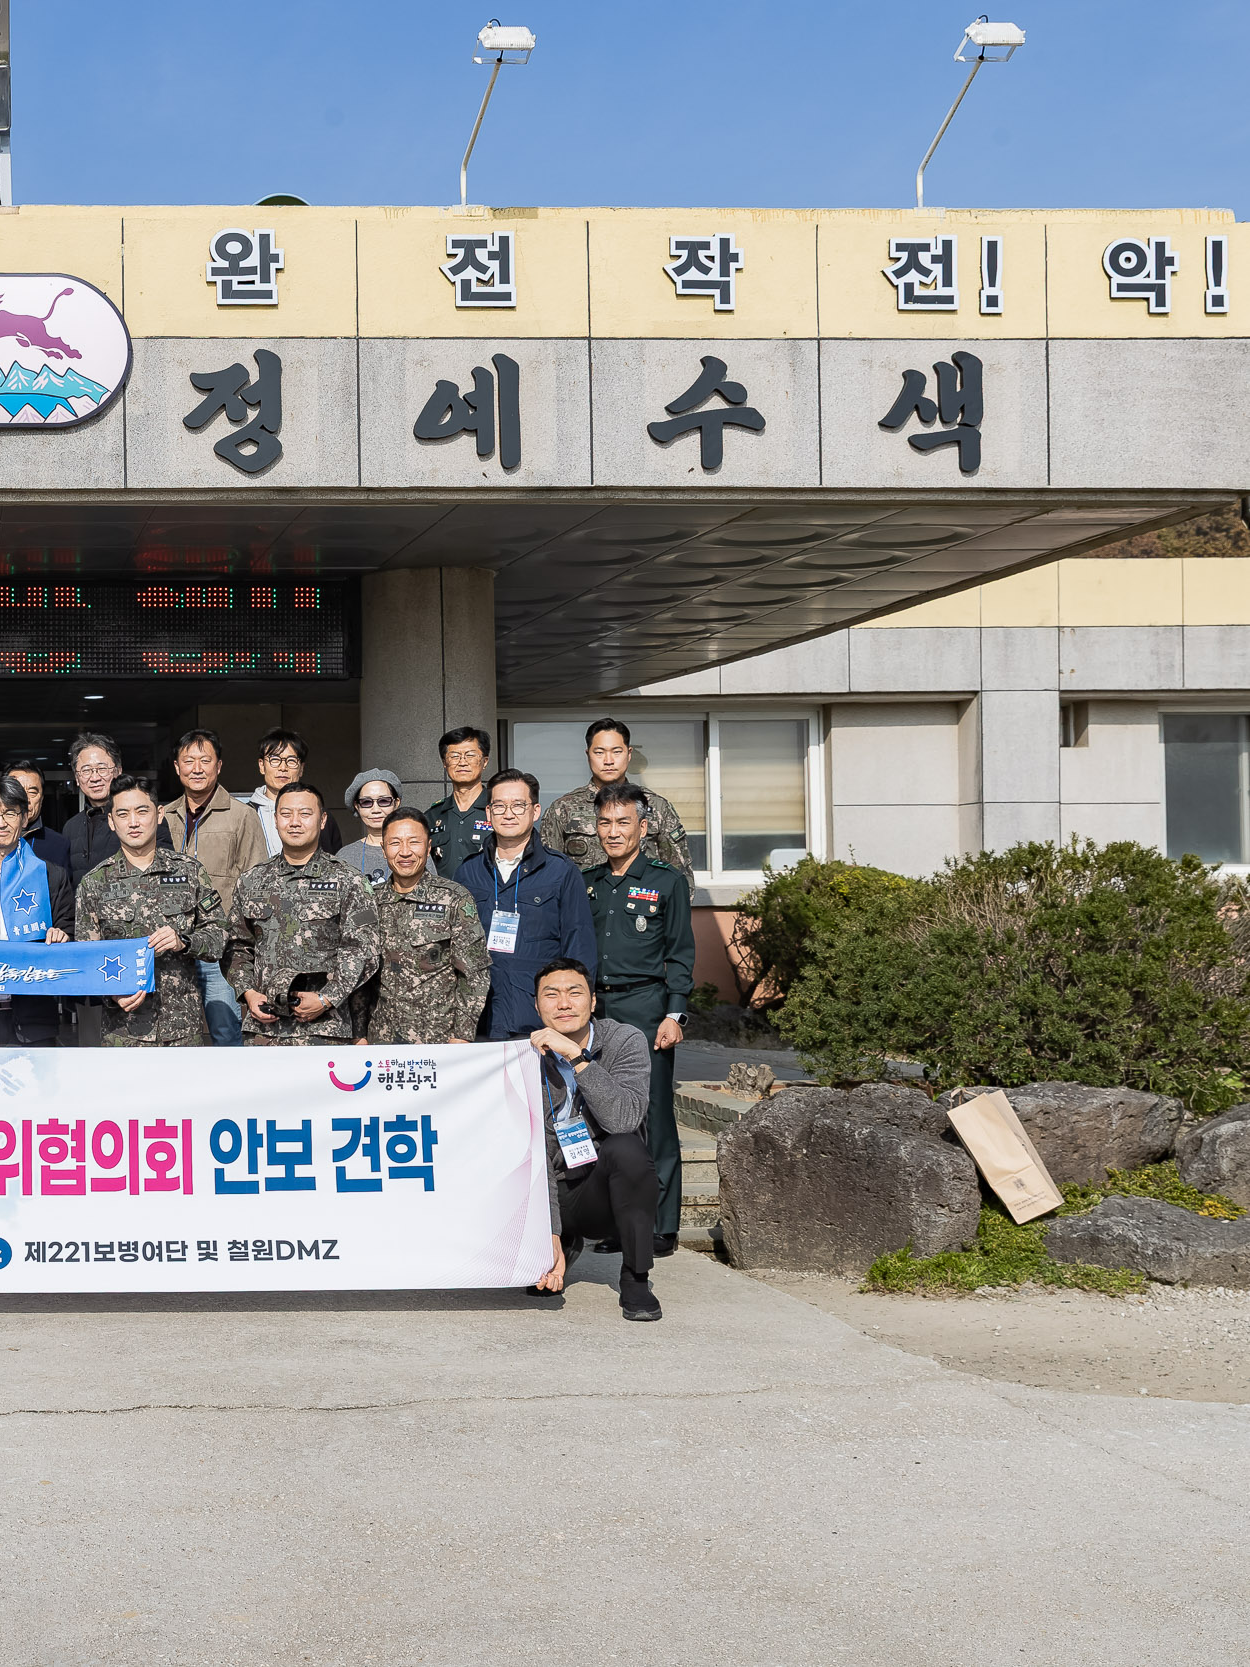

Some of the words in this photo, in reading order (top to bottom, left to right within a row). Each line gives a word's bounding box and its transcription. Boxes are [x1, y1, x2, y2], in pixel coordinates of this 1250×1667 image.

[377, 1070, 437, 1092] 행복광진
[209, 1118, 317, 1195] 안보
[331, 1114, 439, 1193] 견학
[24, 1240, 189, 1263] 제221보병여단
[196, 1240, 219, 1262] 및
[227, 1239, 340, 1262] 철원DMZ
